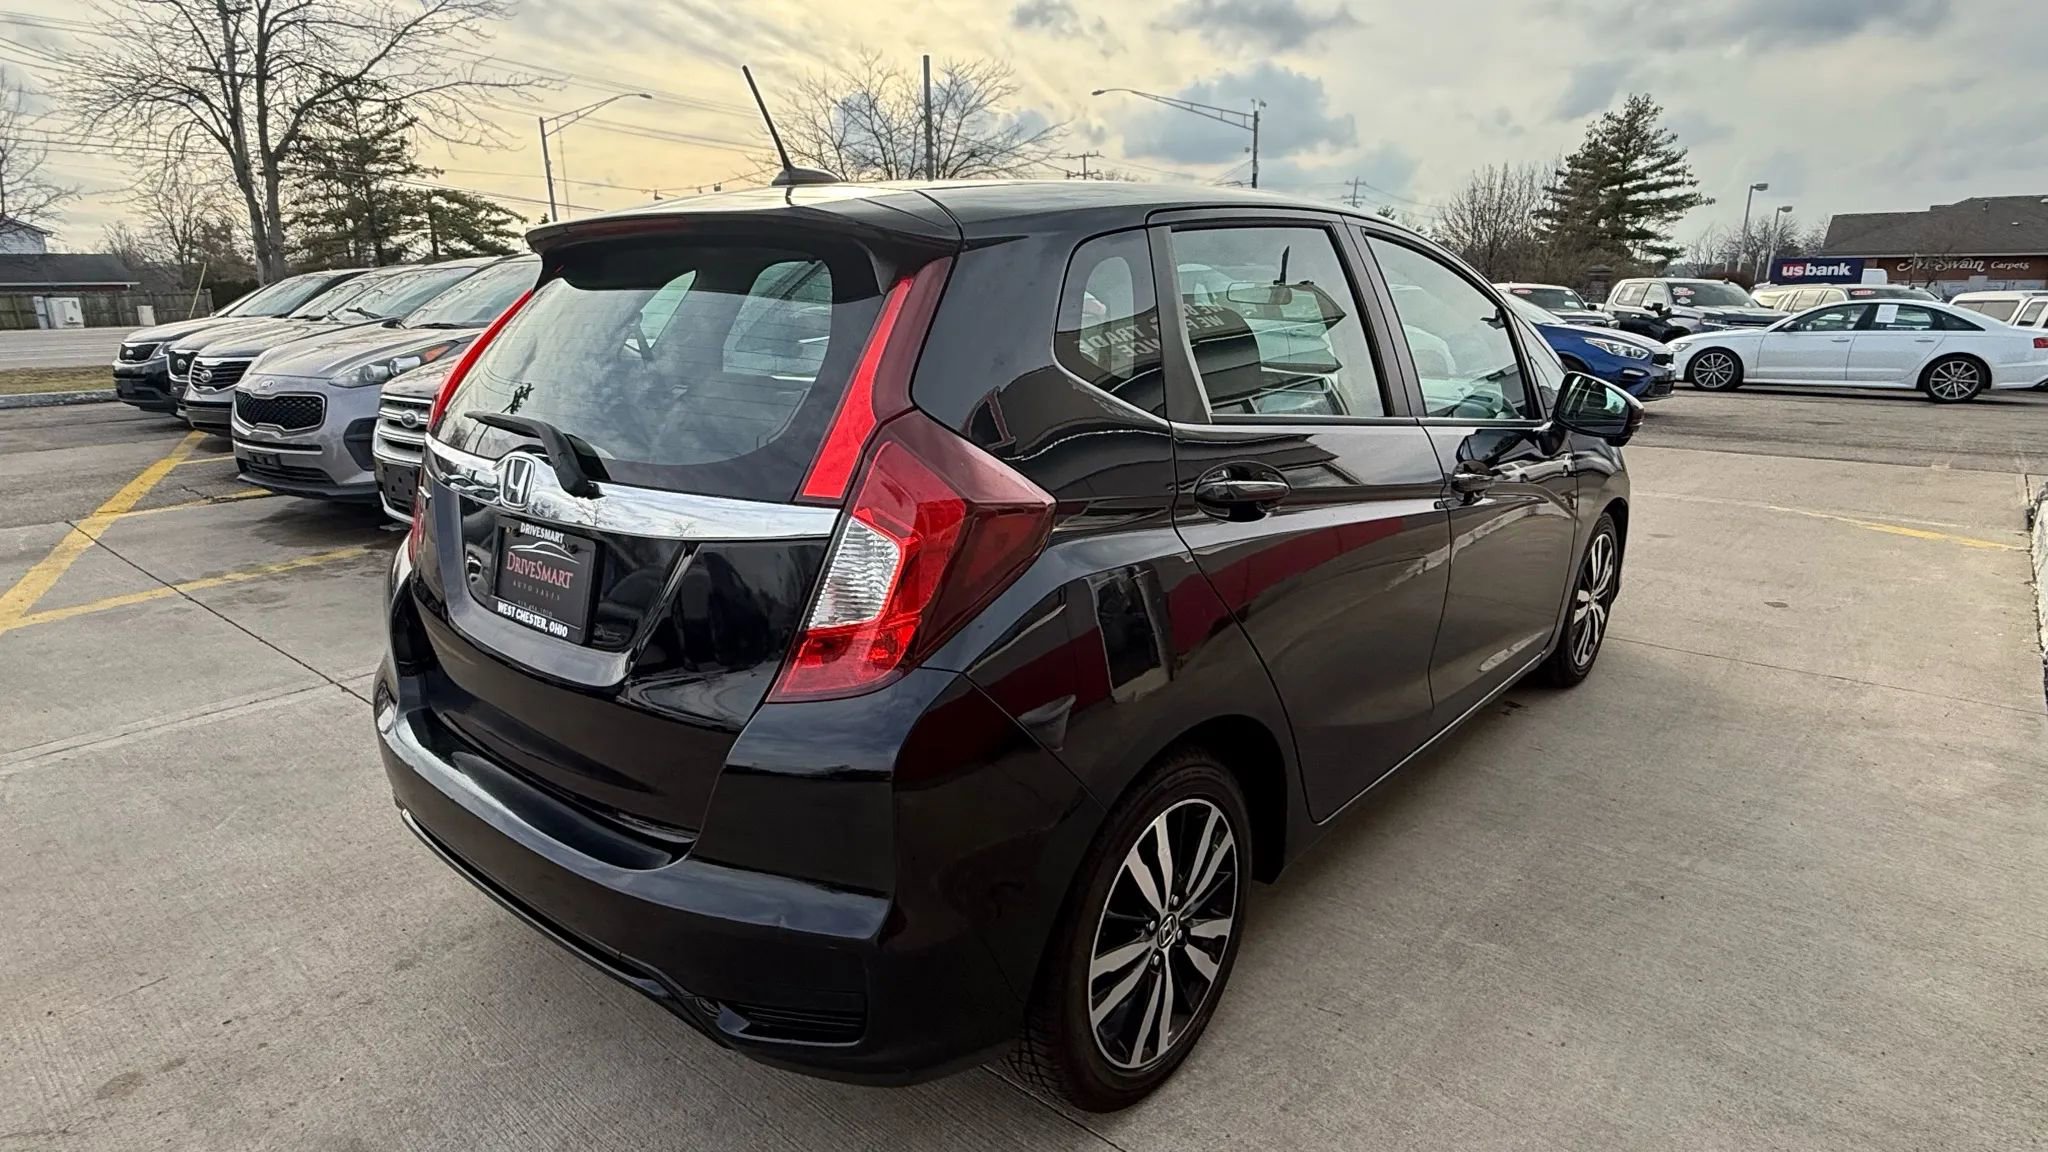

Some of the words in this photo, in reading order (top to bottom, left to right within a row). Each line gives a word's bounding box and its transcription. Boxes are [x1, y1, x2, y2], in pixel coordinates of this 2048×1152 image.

[1990, 262, 2030, 270] Carpets
[520, 522, 564, 543] DRIVESMART
[497, 601, 516, 617] WEST
[549, 621, 568, 637] OHIO
